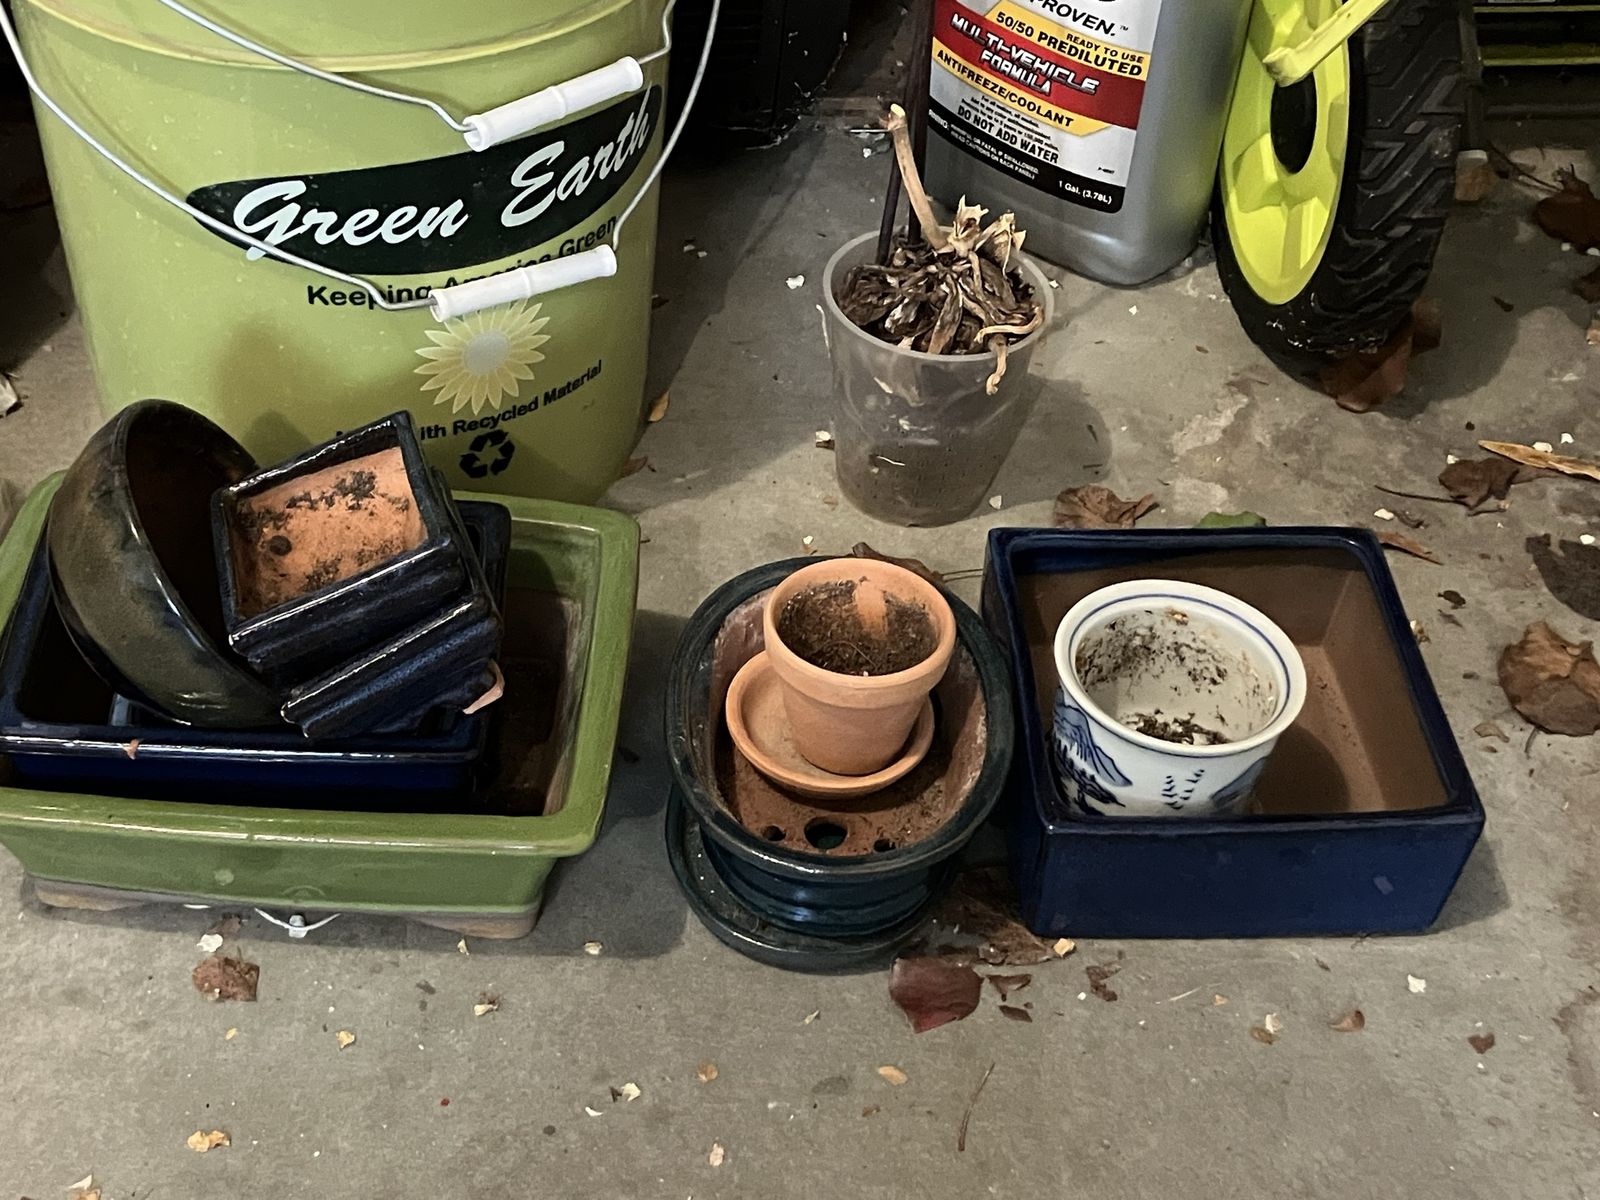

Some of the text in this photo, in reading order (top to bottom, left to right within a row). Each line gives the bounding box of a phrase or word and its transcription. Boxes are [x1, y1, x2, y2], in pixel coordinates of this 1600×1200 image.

[996, 12, 1142, 76] 50/50 PREDILUTED
[1029, 0, 1115, 36] ROVEN.
[1066, 33, 1144, 64] READY TO USE
[951, 13, 1100, 95] MULTI-VEHICLE
[981, 49, 1051, 95] FORMULA
[937, 50, 1074, 127] ANTIFREEZE/COOLANT
[957, 105, 971, 120] DO
[973, 114, 995, 133] NOT
[996, 127, 1017, 145] ADD
[1020, 138, 1059, 164] WATER
[233, 81, 650, 260] Green Earth
[1064, 183, 1080, 194] Gal.
[1082, 190, 1112, 205] (3.78L)
[307, 216, 616, 309] Keeping Green
[420, 360, 602, 441] ith Recycled Material
